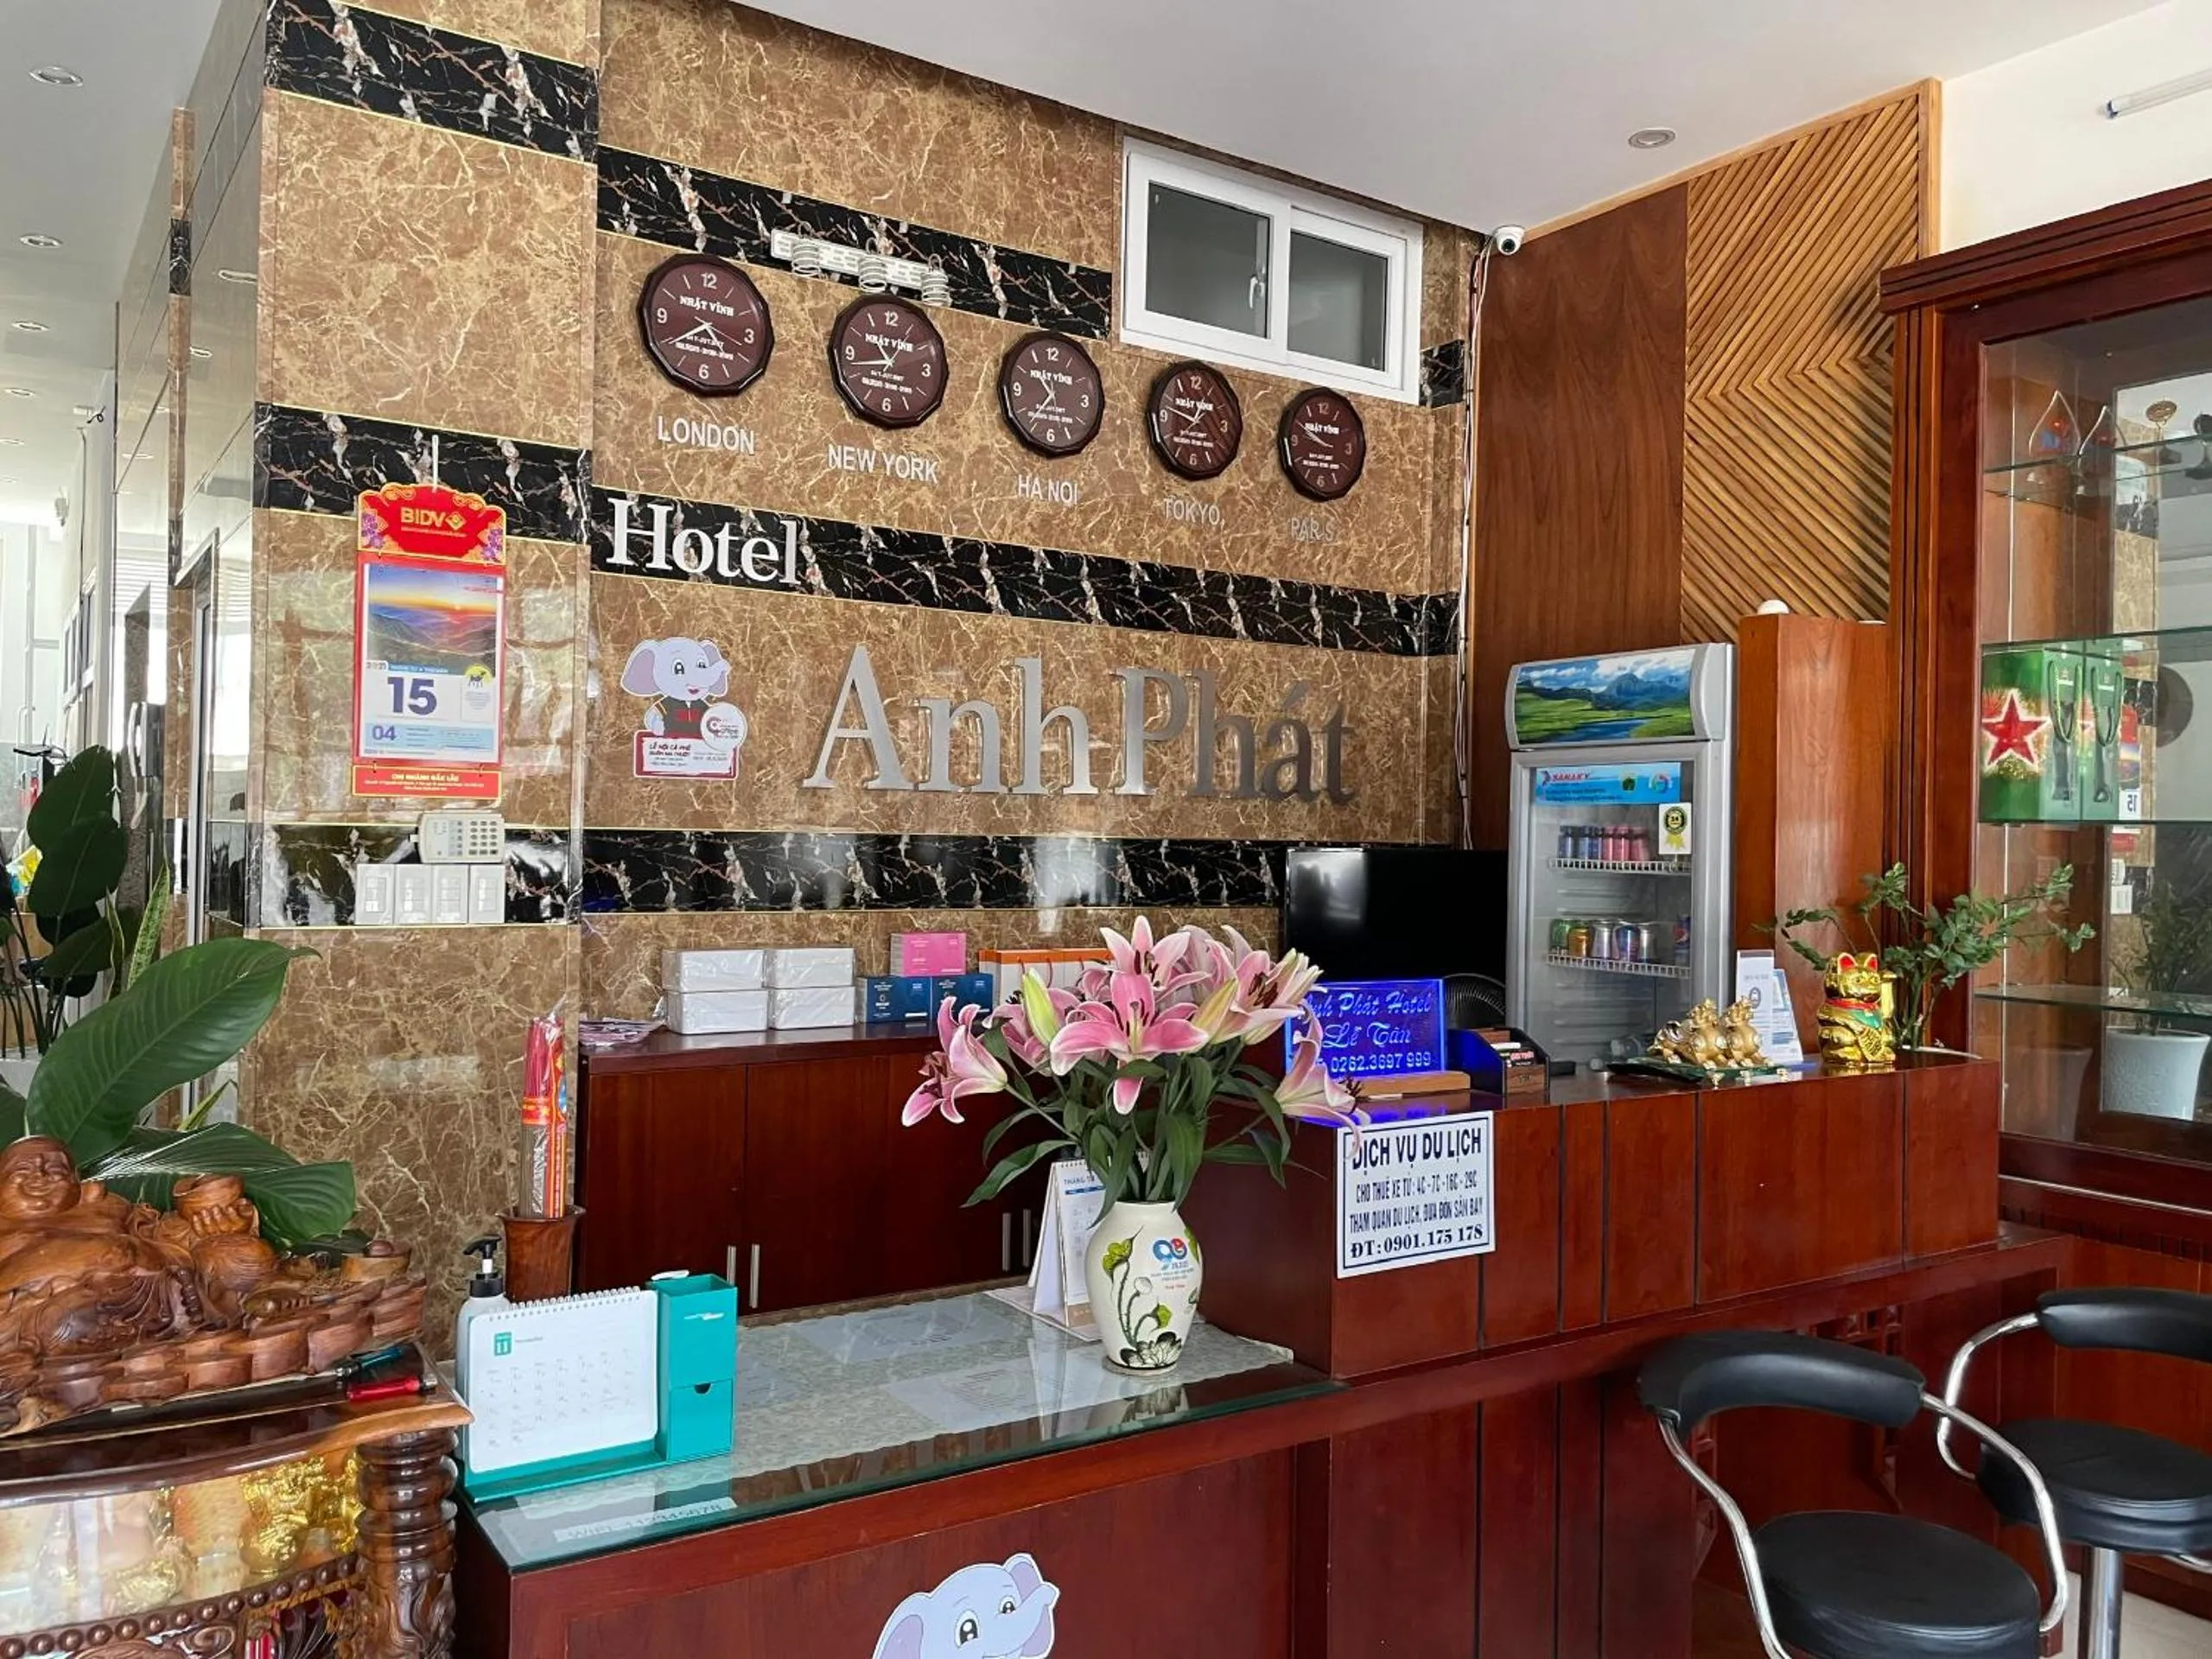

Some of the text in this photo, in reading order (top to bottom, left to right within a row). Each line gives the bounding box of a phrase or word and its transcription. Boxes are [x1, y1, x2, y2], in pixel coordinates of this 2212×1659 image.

[701, 273, 717, 289] 12
[657, 308, 667, 324] 9
[885, 311, 899, 327] 12
[744, 328, 754, 344] 3
[845, 346, 855, 360] 9
[1046, 347, 1059, 361] 12
[698, 364, 709, 378] 6
[921, 363, 931, 377] 3
[1013, 382, 1021, 396] 9
[1190, 375, 1201, 391] 12
[882, 397, 892, 411] 6
[1080, 394, 1089, 408] 3
[1317, 403, 1329, 415] 12
[1160, 410, 1167, 422] 9
[1220, 420, 1227, 432] 3
[657, 415, 755, 455] LONDON
[1046, 429, 1054, 442] 6
[1291, 434, 1298, 446] 9
[1344, 442, 1352, 455] 3
[828, 443, 939, 485] NEW YORK
[1189, 454, 1198, 465] 6
[1317, 475, 1325, 487] 6
[400, 507, 446, 527] BIDV
[1163, 497, 1220, 526] TOKYO
[607, 497, 801, 585] Hotel
[387, 676, 437, 715] 15
[802, 641, 1356, 804] Anh Phát
[372, 725, 397, 741] 04
[1338, 992, 1380, 1018] Phát
[1386, 990, 1432, 1015] Hotel
[1406, 1051, 1432, 1068] 999
[1396, 1134, 1417, 1168] VỤ
[1422, 1131, 1443, 1160] DU
[1447, 1127, 1482, 1163] LỊCH
[1357, 1183, 1370, 1204] CHO
[1392, 1179, 1401, 1198] XE
[1432, 1173, 1440, 1192] 7C
[1446, 1172, 1459, 1192] 16C
[1350, 1211, 1370, 1234] THAM
[1372, 1208, 1391, 1232] QUAN
[1393, 1207, 1403, 1227] DU
[1470, 1198, 1483, 1217] BAY
[1459, 1224, 1483, 1243] 178
